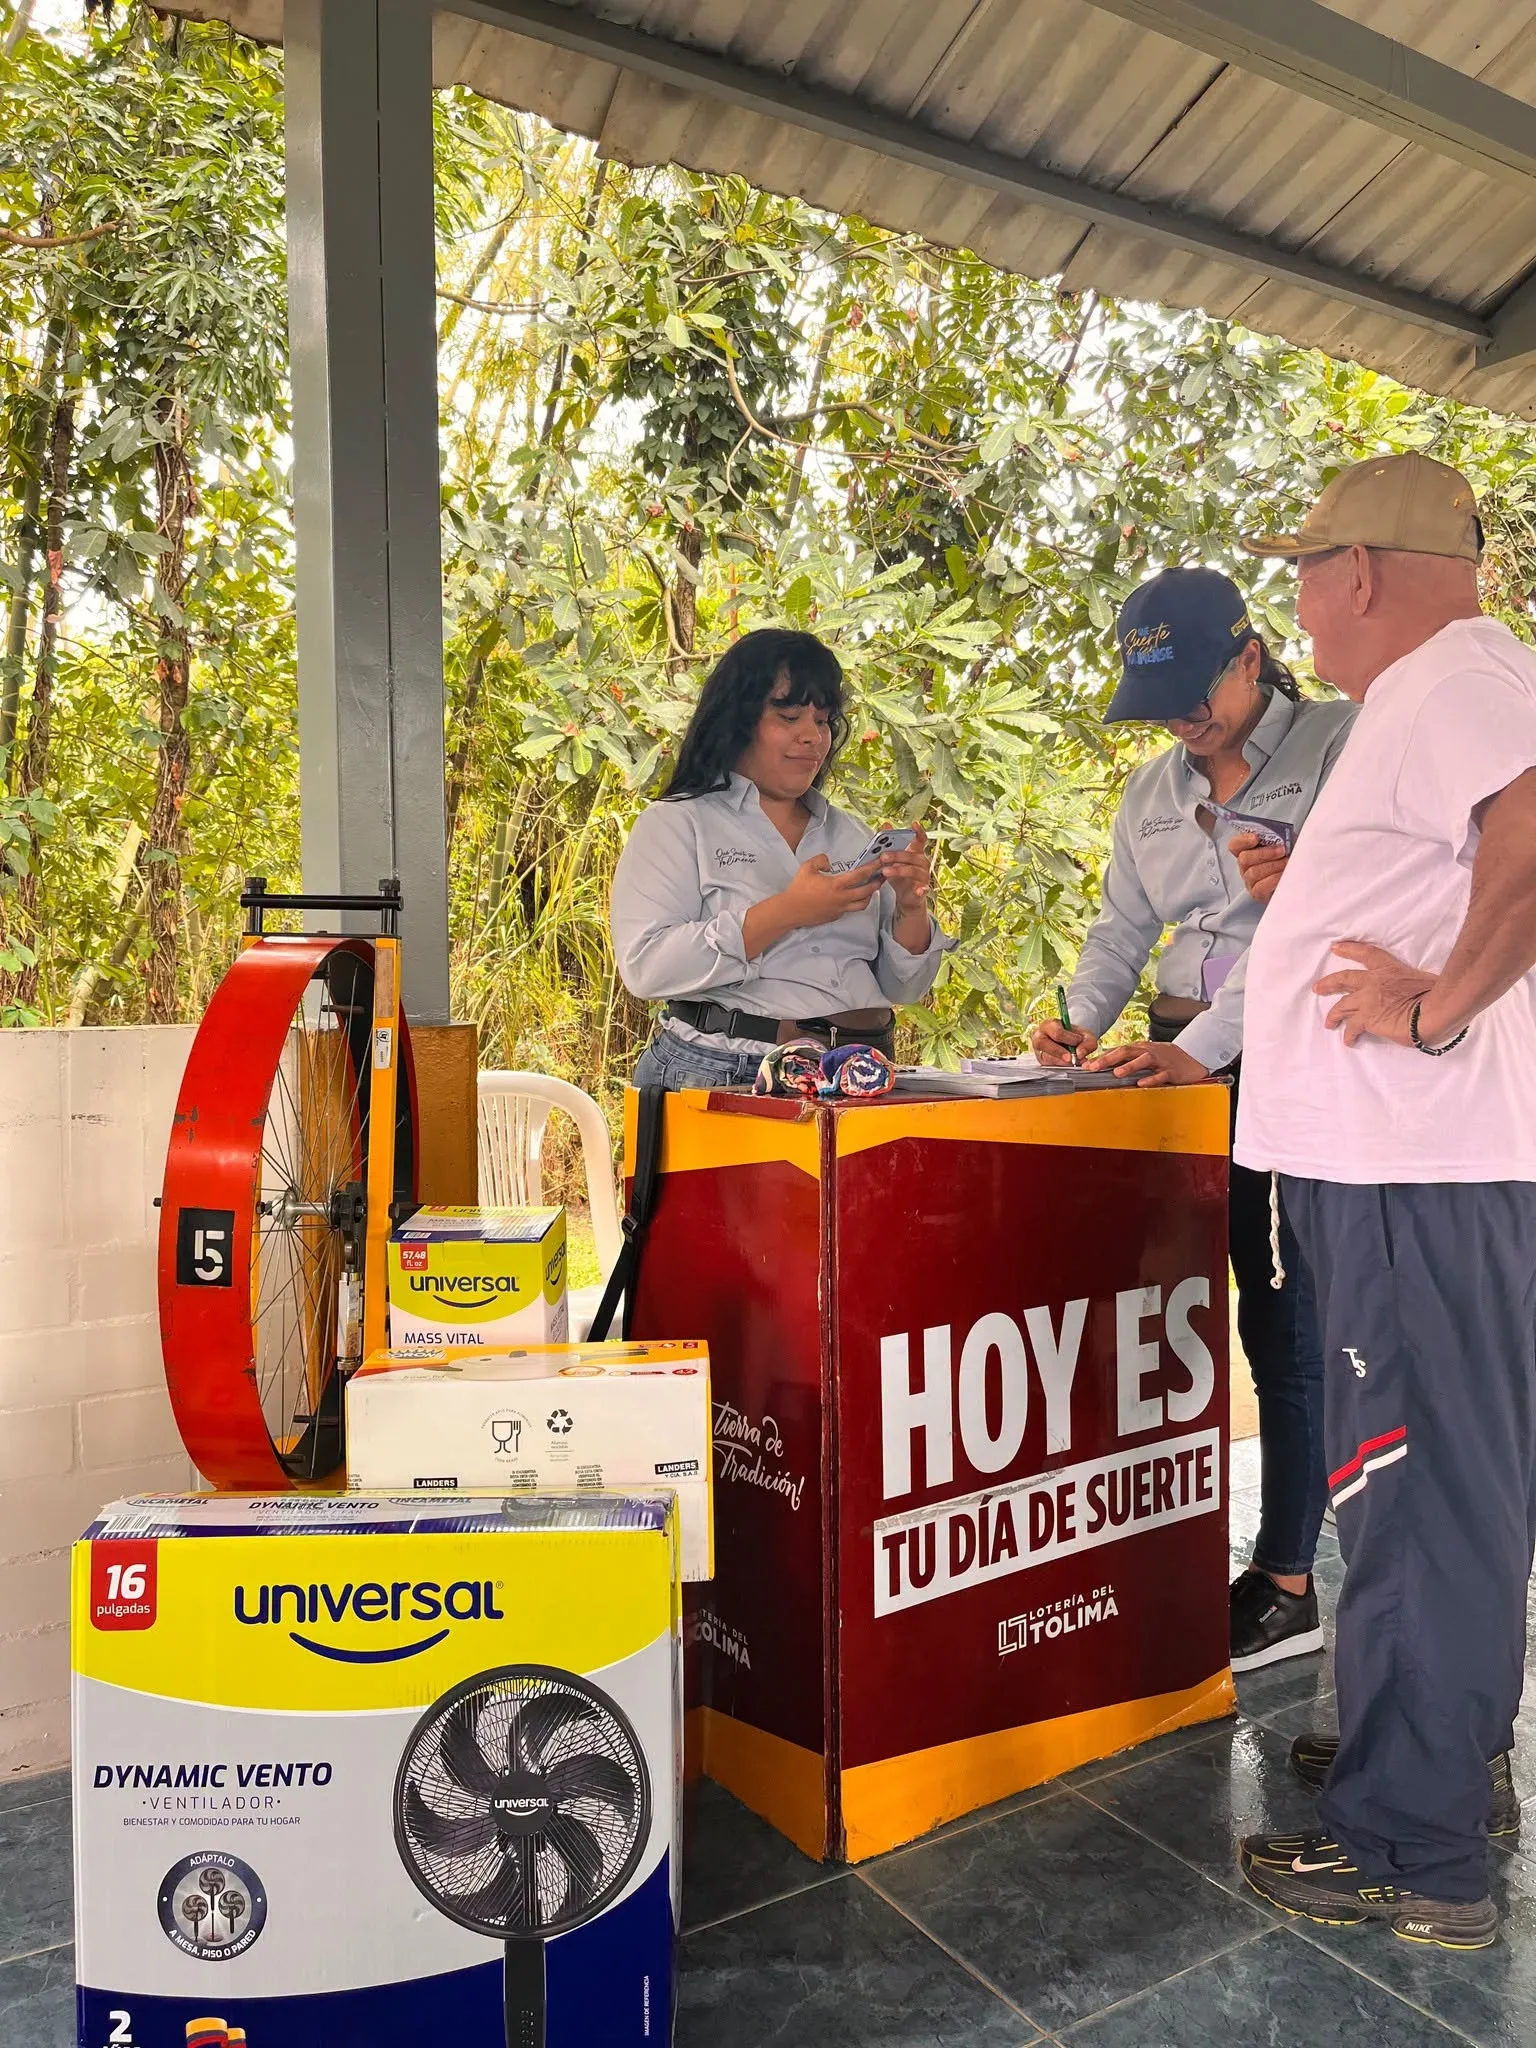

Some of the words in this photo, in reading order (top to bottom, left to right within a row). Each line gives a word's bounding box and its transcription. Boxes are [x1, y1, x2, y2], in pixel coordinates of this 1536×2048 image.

[1266, 786, 1303, 802] TOLIMA
[194, 1230, 224, 1281] 5
[410, 1276, 520, 1292] universal
[405, 1333, 442, 1344] MASS
[446, 1333, 484, 1344] VITAL
[880, 1297, 1089, 1500] HOY
[1116, 1276, 1215, 1437] ES
[762, 1416, 784, 1457] de
[657, 1462, 697, 1473] LANDERS
[712, 1440, 805, 1511] Tradición!
[882, 1521, 937, 1598] TU
[949, 1493, 1019, 1578] DÍA
[1029, 1481, 1076, 1552] DE
[1086, 1443, 1213, 1534] SUERTE
[106, 1563, 146, 1600] 16
[97, 1602, 151, 1617] pulgadas
[234, 1580, 504, 1625] universal
[1029, 1594, 1085, 1620] LOTERÍA
[1092, 1584, 1115, 1599] DEL
[1029, 1597, 1119, 1644] TOLIMA
[732, 1628, 748, 1646] DEL
[93, 1764, 228, 1789] DYNAMIC
[235, 1762, 333, 1787] VENTO
[494, 1798, 550, 1809] universal
[123, 1817, 169, 1826] BIENESTAR
[171, 1817, 177, 1825] Y
[179, 1817, 230, 1826] COMODIDAD
[231, 1817, 254, 1826] PARA
[256, 1817, 268, 1825] TU
[270, 1816, 301, 1825] HOGAR
[190, 1853, 235, 1867] ADÁPTALO
[1405, 1921, 1433, 1934] NIKE
[169, 1929, 178, 1938] A
[201, 1949, 223, 1958] PISO
[223, 1947, 231, 1956] O
[231, 1929, 256, 1953] PARED
[109, 2010, 132, 2043] 2
